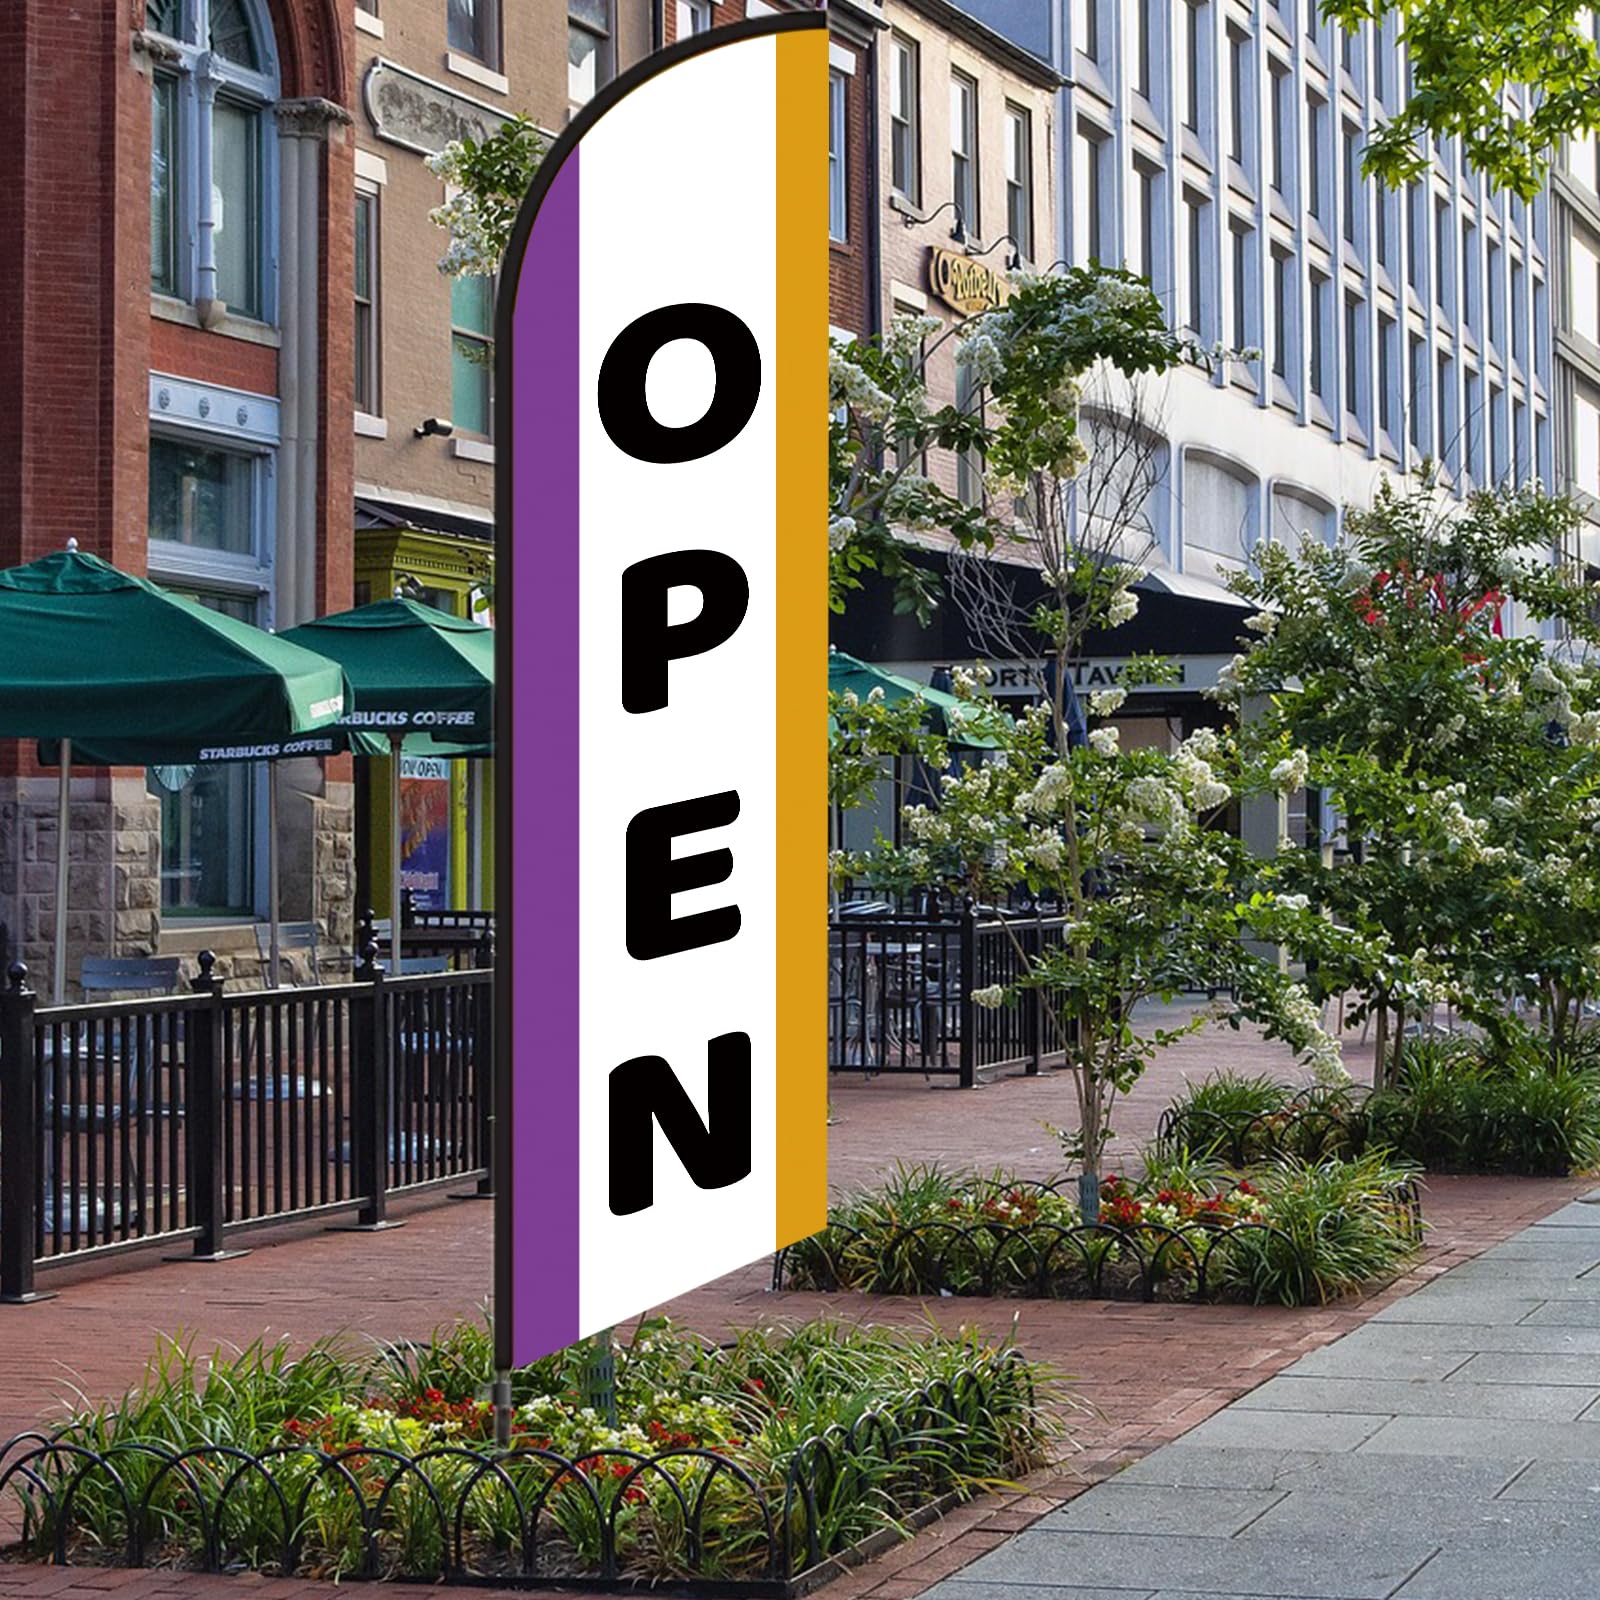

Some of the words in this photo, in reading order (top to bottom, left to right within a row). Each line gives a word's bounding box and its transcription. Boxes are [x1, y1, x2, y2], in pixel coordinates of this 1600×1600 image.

[413, 711, 475, 725] COFFEE
[199, 744, 279, 760] STARBUCKS
[283, 738, 333, 753] COFFEE
[598, 303, 761, 1216] OPEN
